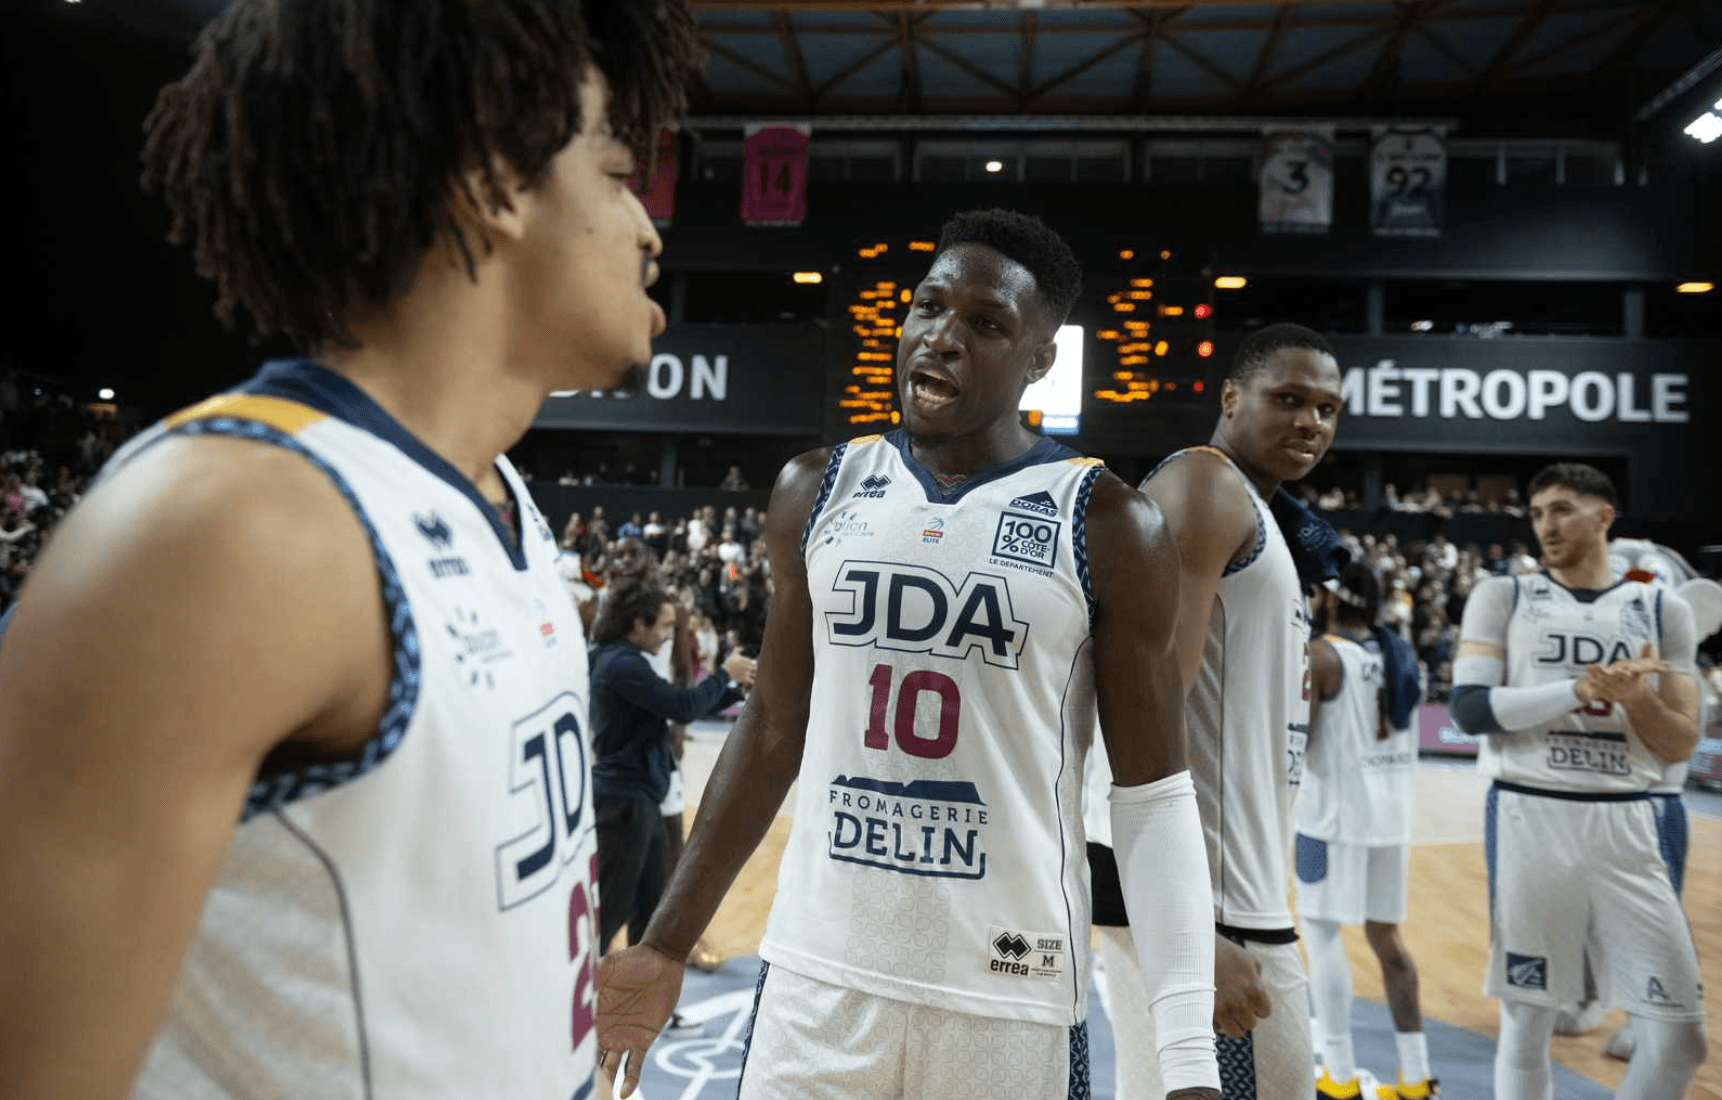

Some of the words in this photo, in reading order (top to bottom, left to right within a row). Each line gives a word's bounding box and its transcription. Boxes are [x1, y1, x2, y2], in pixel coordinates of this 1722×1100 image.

[1283, 160, 1311, 194] 3
[1385, 166, 1432, 200] 92
[1341, 358, 1690, 424] MÉTROPOLE
[1009, 499, 1058, 517] DORAS
[1005, 521, 1052, 543] 100
[1020, 547, 1045, 559] D'OR
[832, 568, 1018, 658] JDA
[1538, 634, 1632, 667] JDA
[864, 663, 961, 760] 10
[1550, 746, 1627, 770] DELIN
[829, 789, 988, 826] FROMAGERIE
[833, 810, 978, 867] DELIN
[568, 853, 599, 1053] 2
[1036, 938, 1063, 950] SIZE
[1042, 954, 1054, 967] M
[990, 959, 1029, 975] errea
